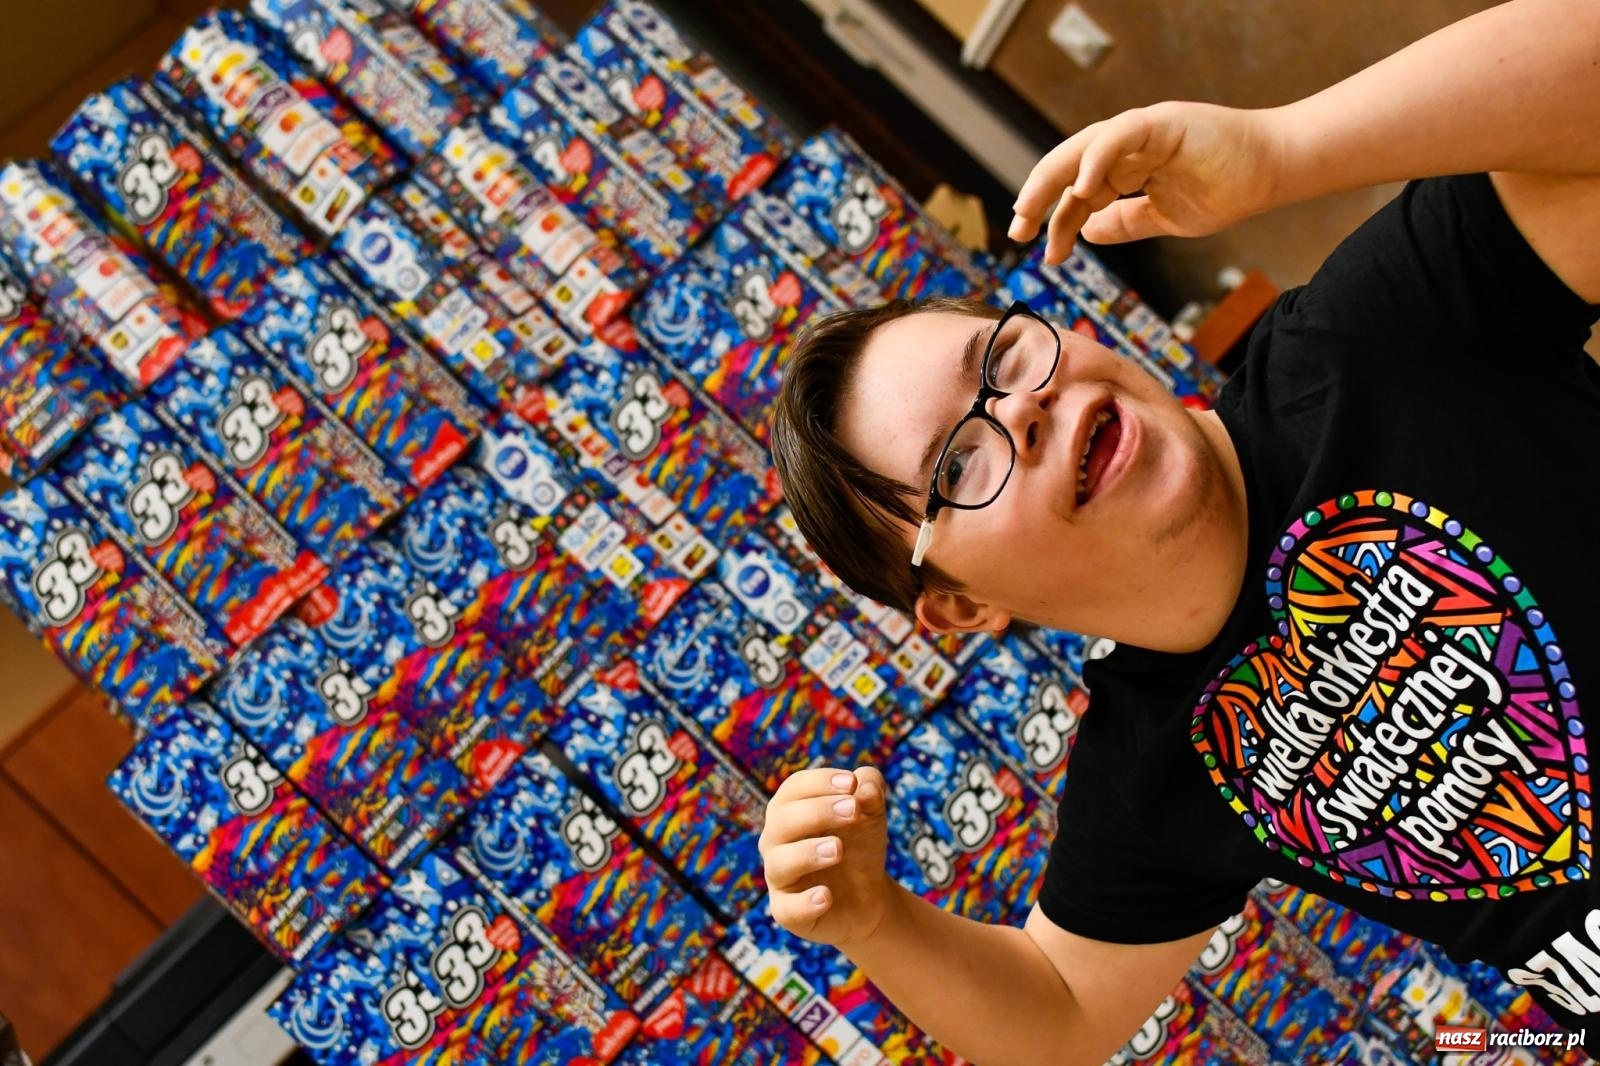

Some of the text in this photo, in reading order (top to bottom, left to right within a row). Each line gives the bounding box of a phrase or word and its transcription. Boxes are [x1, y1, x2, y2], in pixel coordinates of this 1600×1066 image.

[120, 135, 176, 222] 33
[308, 305, 374, 391] 33
[219, 375, 285, 466] 33
[613, 372, 672, 458] 33
[130, 451, 197, 544] 33
[34, 528, 100, 624] 33
[1019, 681, 1079, 771] 33
[1253, 564, 1434, 801] wielka orkiestra
[615, 719, 681, 814] 33
[1306, 629, 1502, 850] świątecznej
[945, 755, 1010, 851] 33
[1399, 718, 1537, 862] pomocy
[434, 908, 499, 1007] 33
[1507, 908, 1600, 1015] SZA
